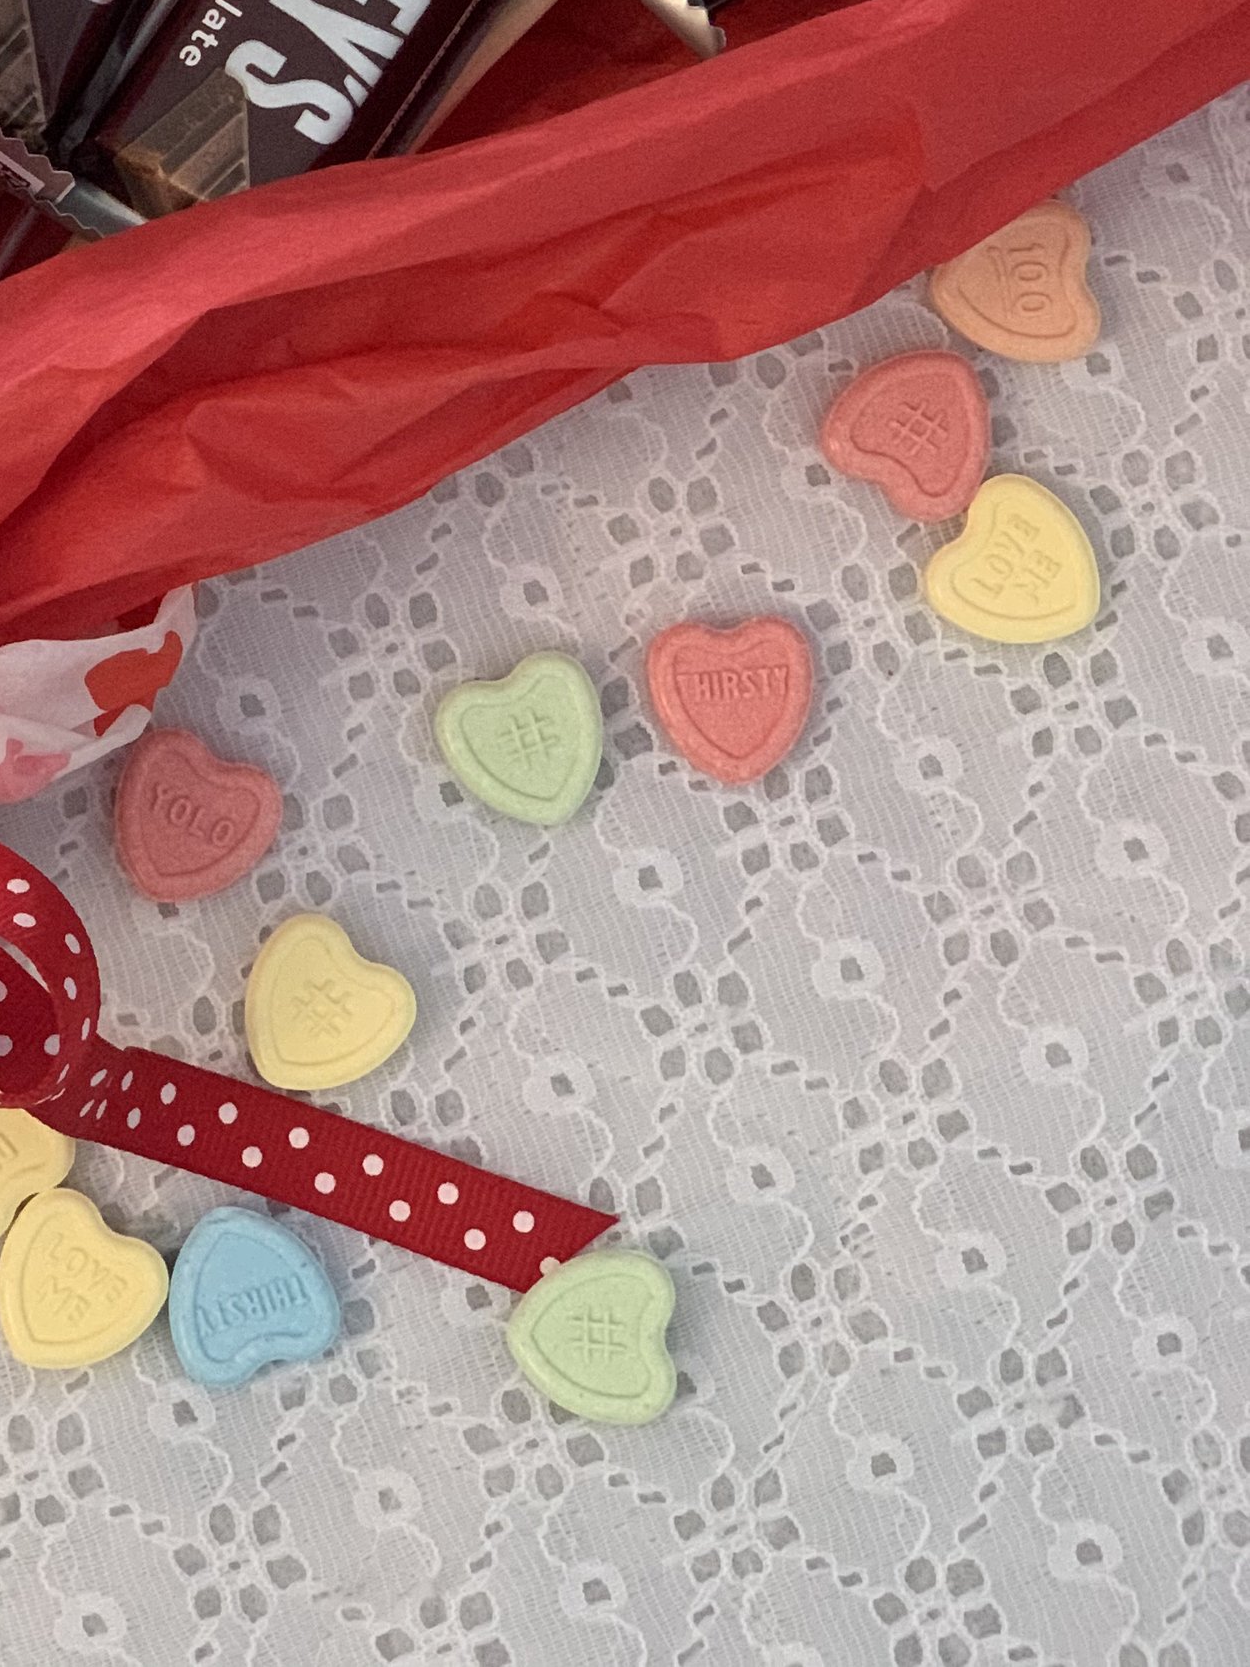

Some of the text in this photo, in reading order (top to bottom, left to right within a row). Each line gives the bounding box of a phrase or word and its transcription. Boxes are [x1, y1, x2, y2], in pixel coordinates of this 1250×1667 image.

[1008, 244, 1049, 317] 100
[968, 512, 1039, 598] LOVE
[1010, 547, 1062, 604] ME
[675, 666, 787, 699] THIRSTY
[143, 782, 238, 850] YOLO
[37, 1273, 93, 1328] ME
[45, 1233, 129, 1309] LOVE
[195, 1272, 308, 1336] THIRSTY
